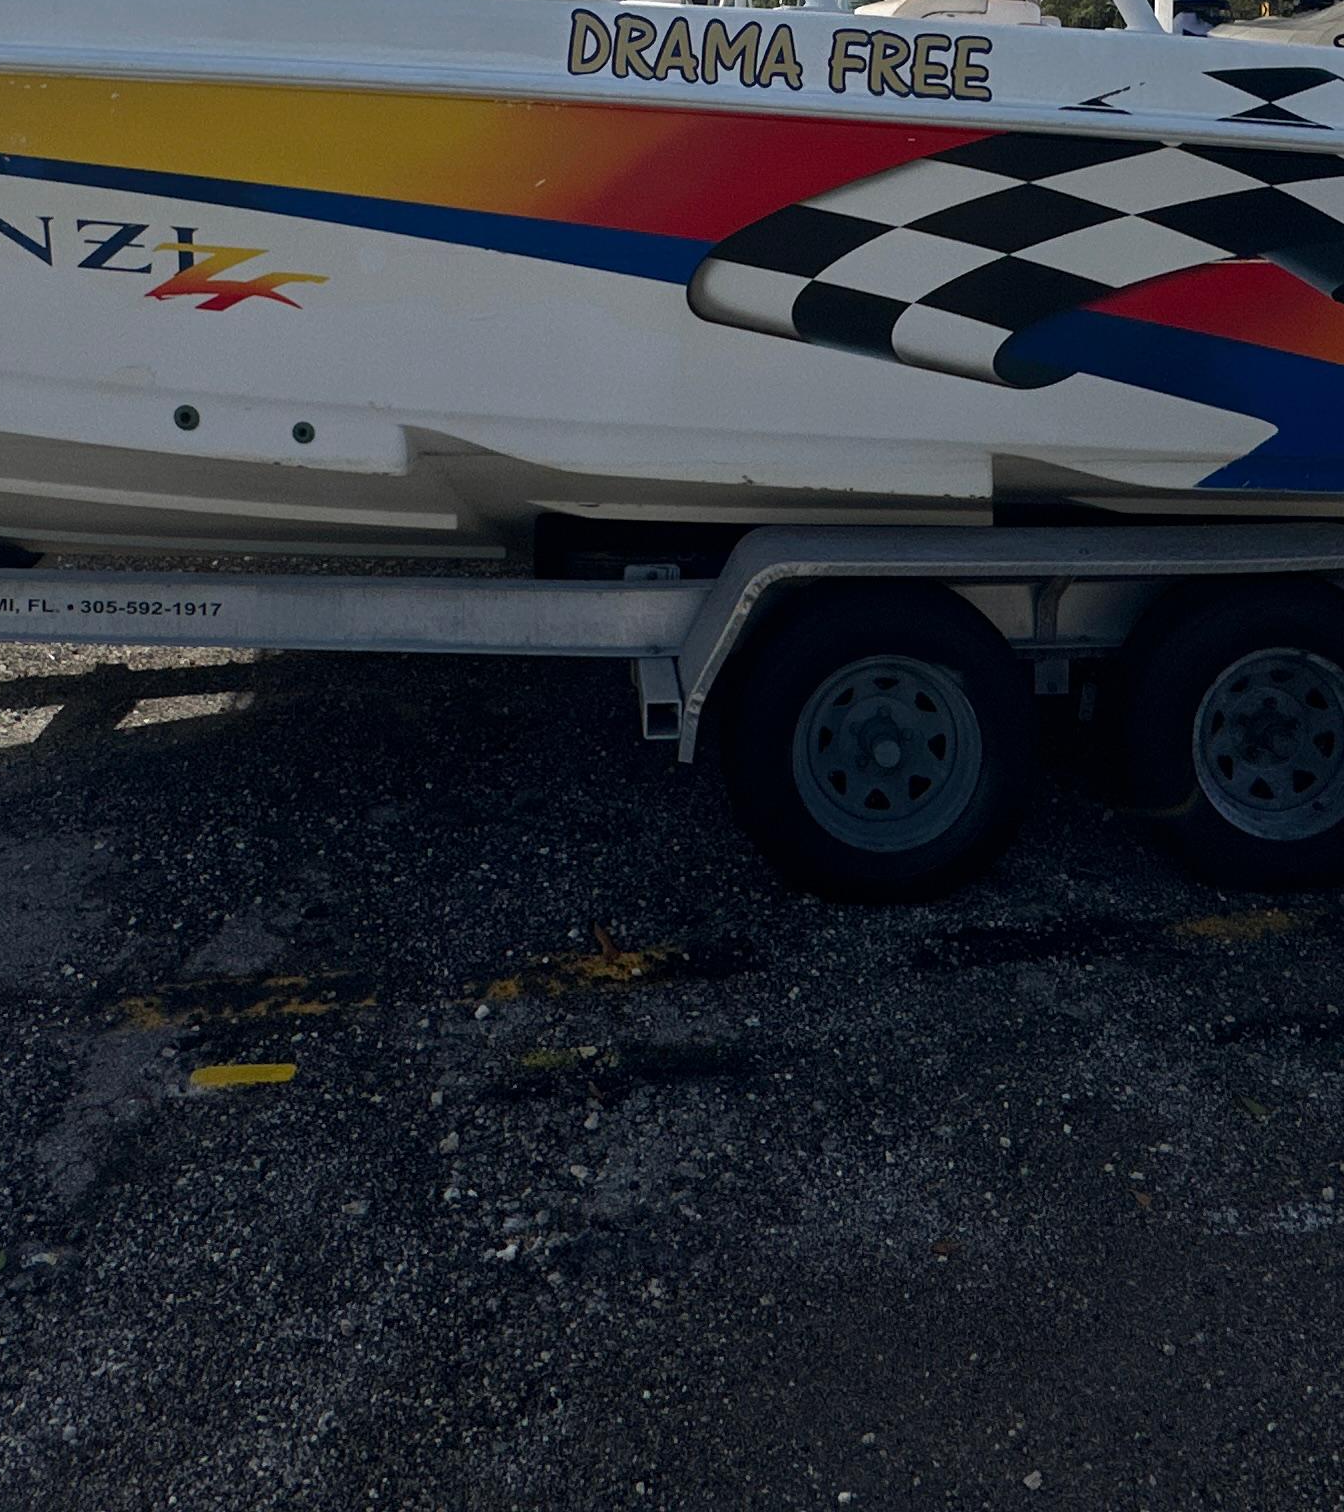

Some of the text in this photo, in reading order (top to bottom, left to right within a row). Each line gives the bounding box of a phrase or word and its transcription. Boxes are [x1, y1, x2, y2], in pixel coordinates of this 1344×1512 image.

[567, 8, 993, 102] DRAMA FREE
[80, 599, 223, 617] 305-592-1917
